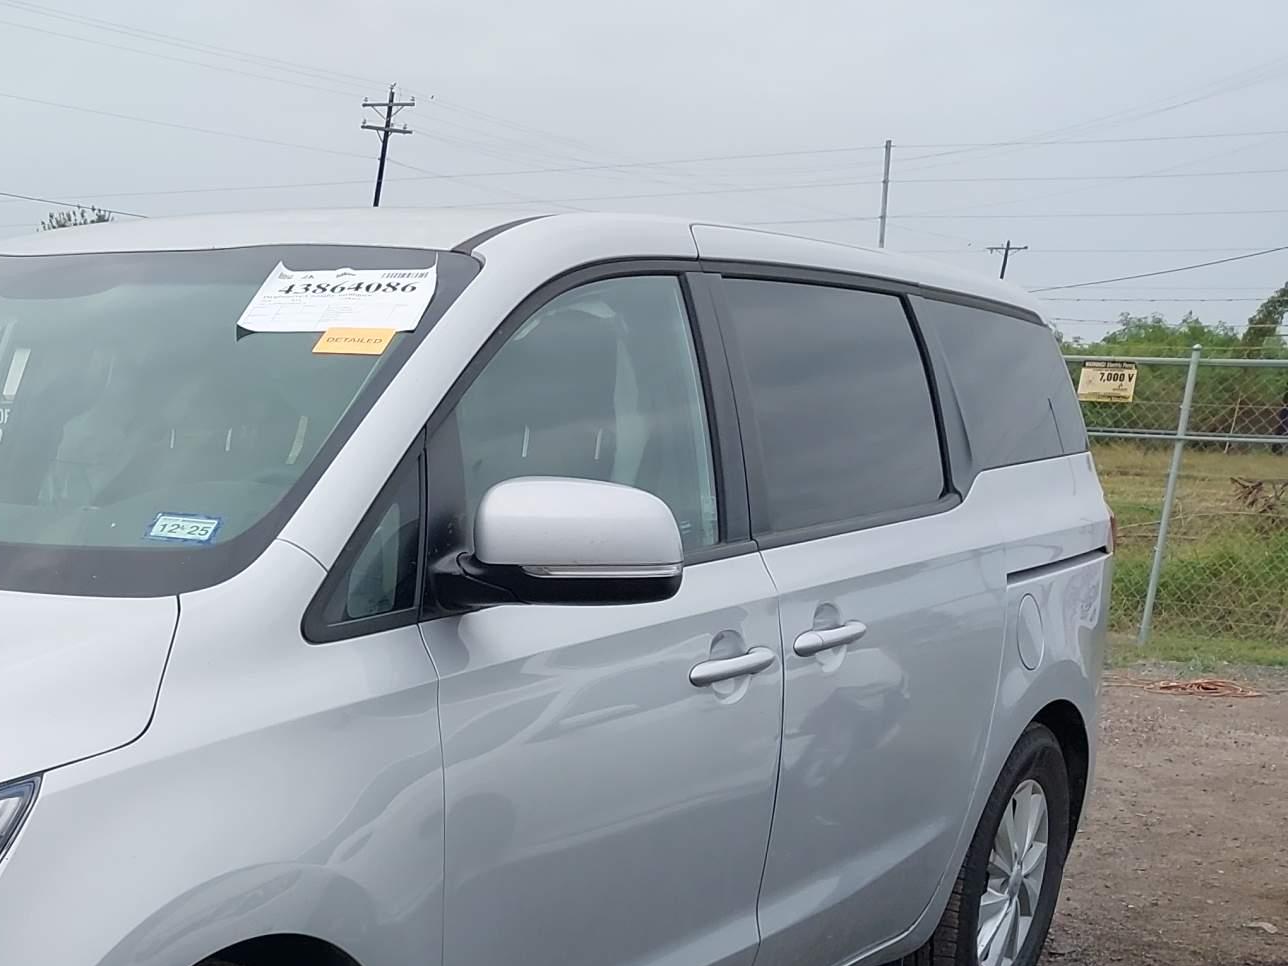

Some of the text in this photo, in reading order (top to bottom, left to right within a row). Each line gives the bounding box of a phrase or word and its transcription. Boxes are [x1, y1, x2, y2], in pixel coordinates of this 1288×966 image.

[278, 281, 418, 294] 43864086
[326, 336, 383, 344] DETAILED
[1099, 372, 1135, 383] 7,000 V
[159, 523, 212, 537] 12 25
